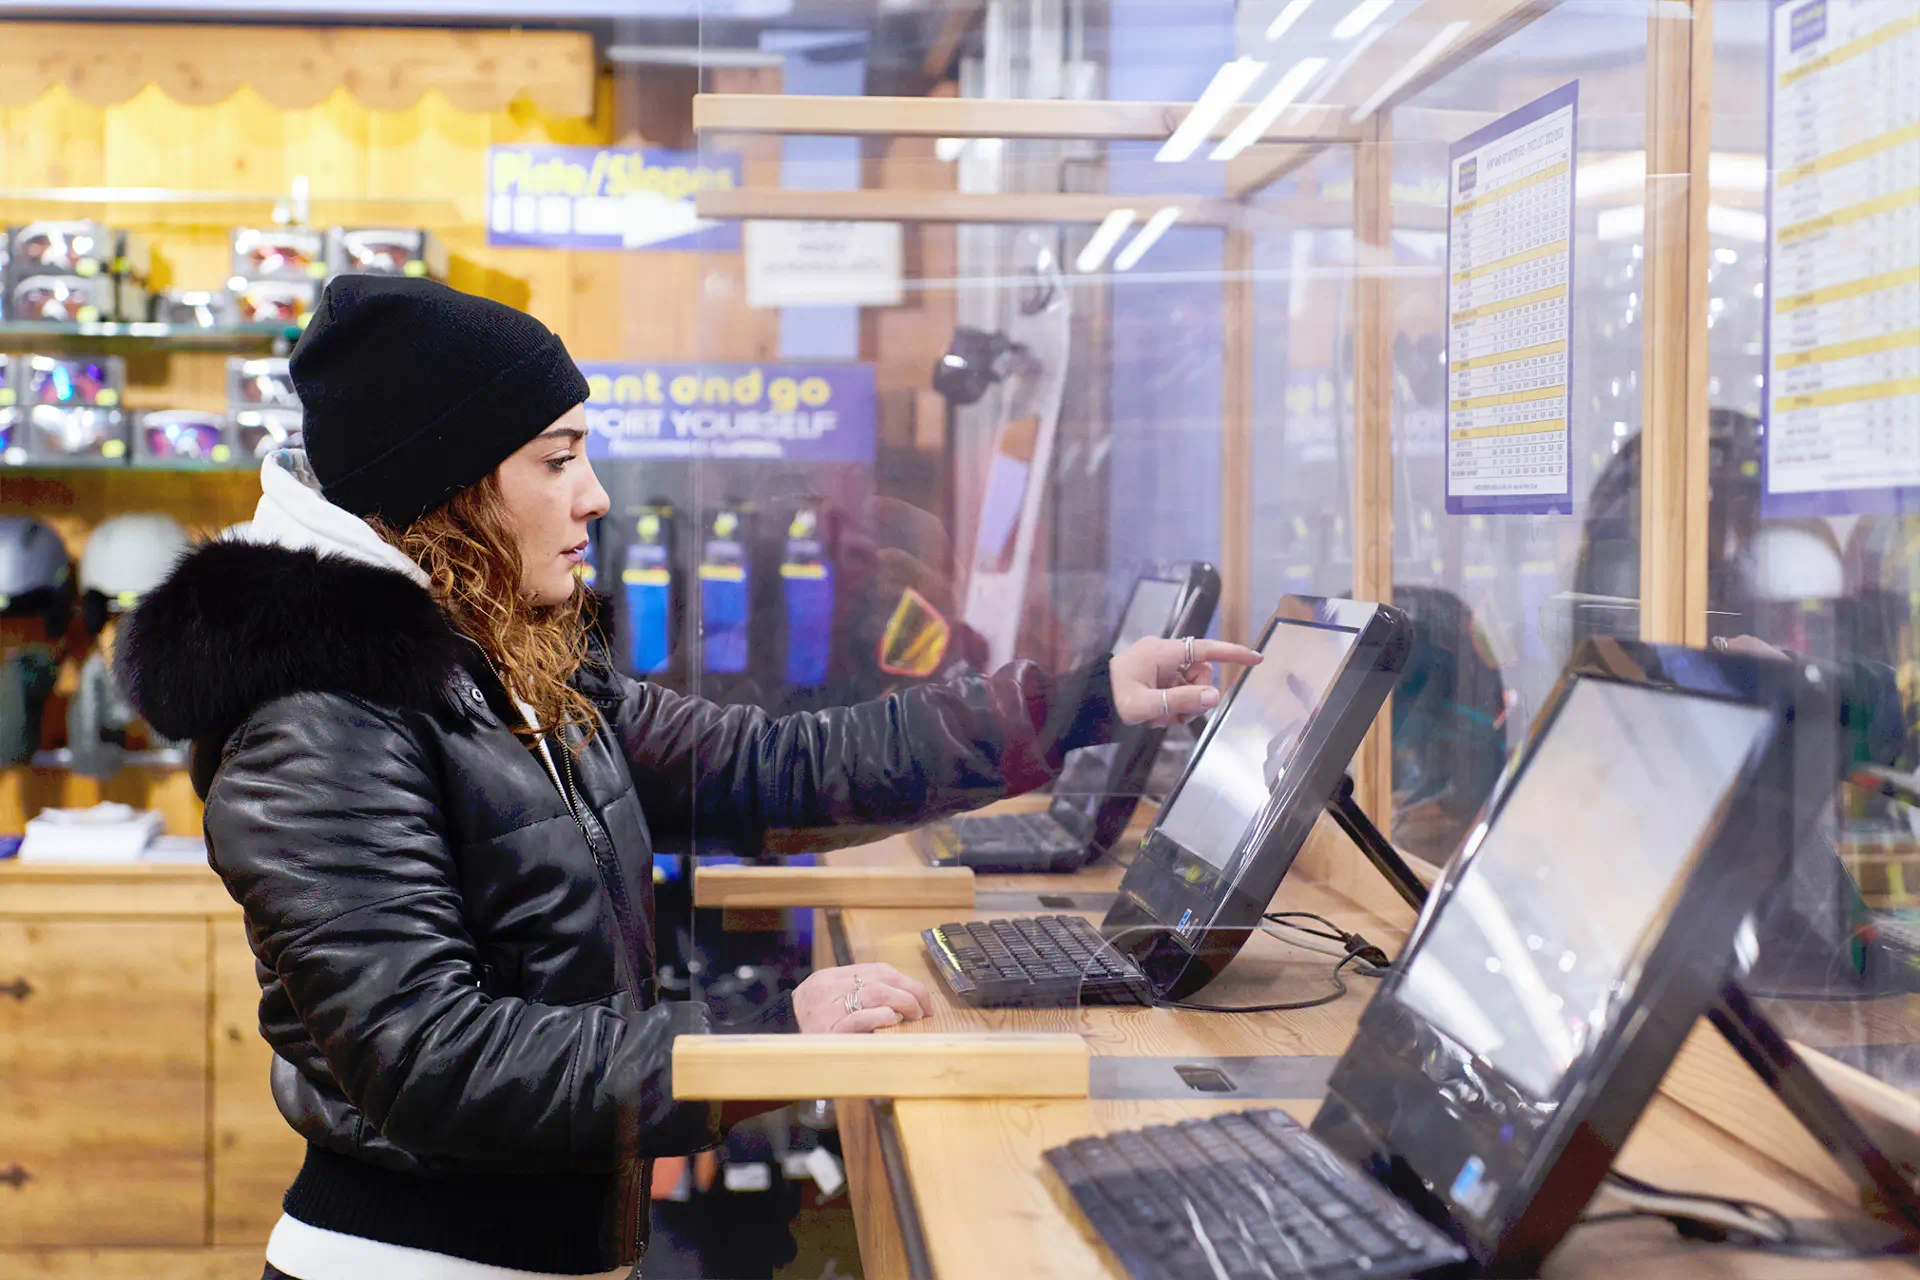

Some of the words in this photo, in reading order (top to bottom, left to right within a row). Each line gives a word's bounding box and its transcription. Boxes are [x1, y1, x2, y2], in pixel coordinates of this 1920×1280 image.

[587, 370, 662, 404] ent
[670, 368, 762, 405] and
[768, 378, 831, 412] go
